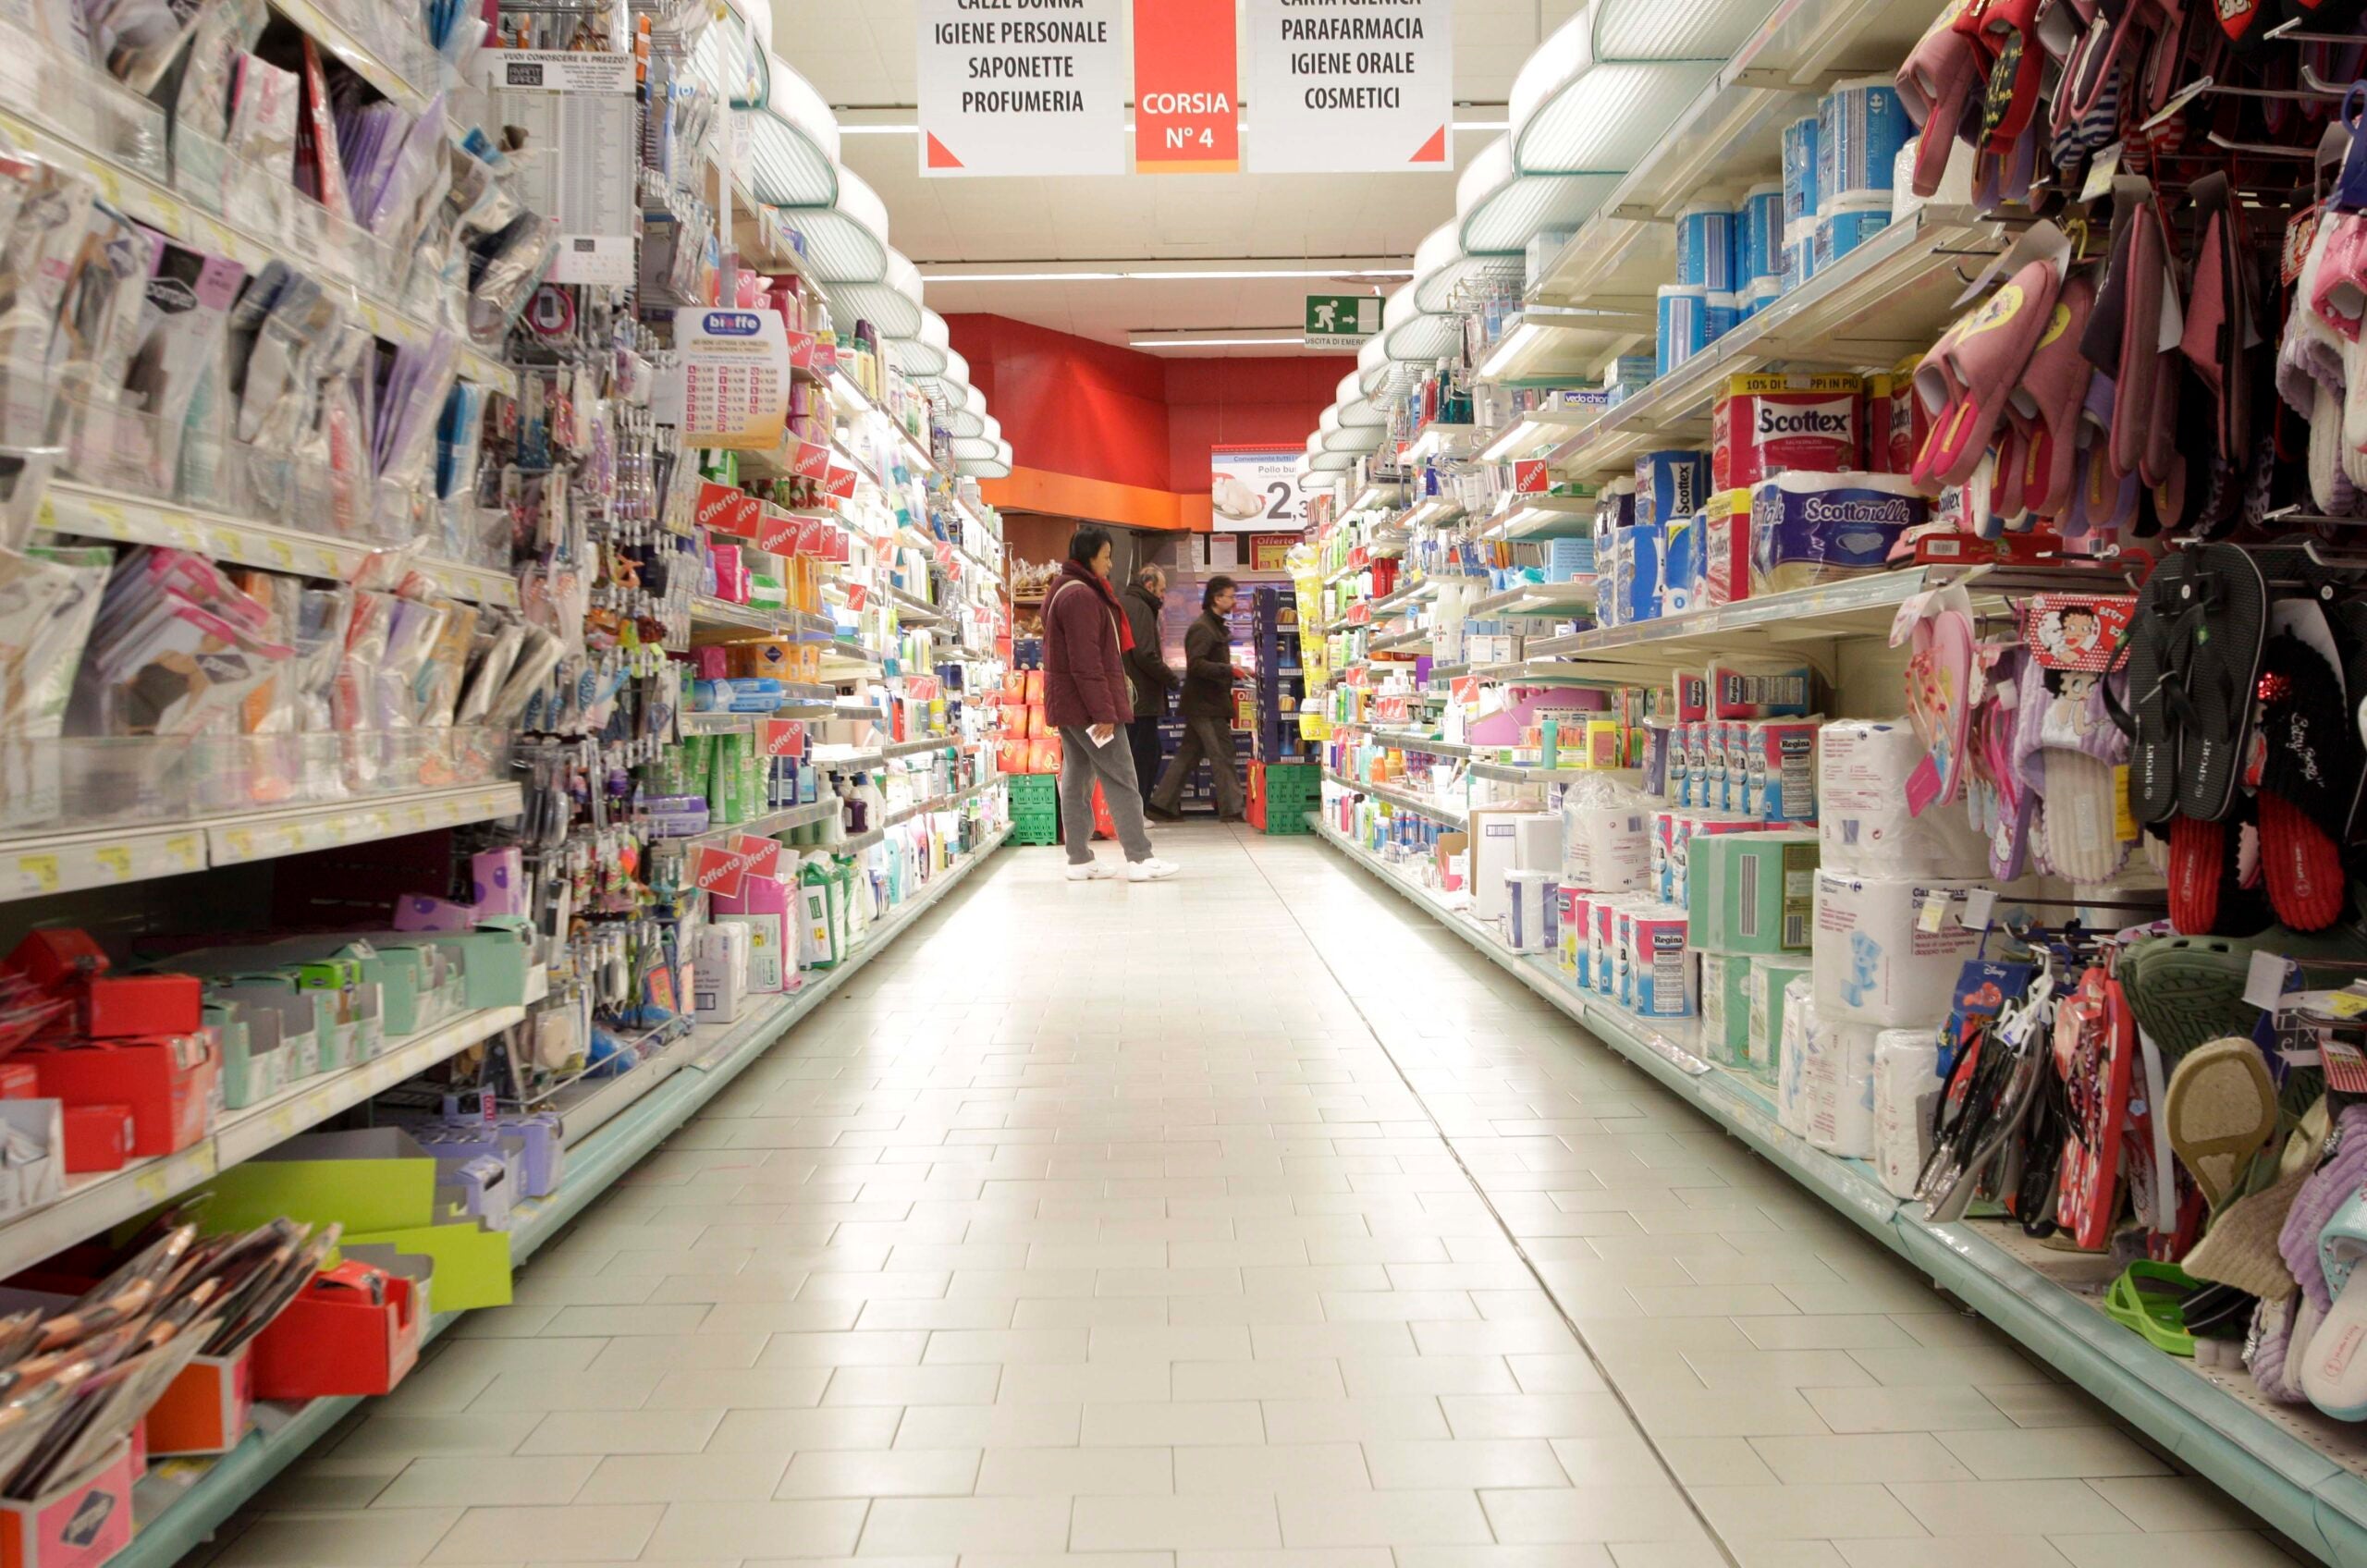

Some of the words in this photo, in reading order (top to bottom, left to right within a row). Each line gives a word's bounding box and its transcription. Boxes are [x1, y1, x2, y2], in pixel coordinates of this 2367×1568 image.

[936, 22, 996, 44] IGIENE
[1001, 21, 1108, 43] PERSONALE
[1282, 18, 1424, 40] PARAFARMACIA
[968, 55, 1073, 78] SAPONETTE
[1292, 53, 1352, 74] IGIENE
[1356, 52, 1415, 73] ORALE
[963, 91, 1084, 113] PROFUMERIA
[1142, 92, 1230, 114] CORSIA
[1305, 87, 1400, 109] COSMETICI
[1165, 128, 1194, 150] N°
[1198, 128, 1214, 148] 4
[1747, 379, 1767, 390] 10%
[1770, 378, 1782, 389] DI
[1829, 377, 1839, 388] IN
[1758, 408, 1847, 434] Scottex
[794, 449, 828, 473] Offerta
[1257, 465, 1281, 473] Pollo
[825, 472, 855, 495] Offerta
[1518, 461, 1545, 492] Offerta
[1677, 464, 1690, 514] Scottex
[698, 490, 739, 523] Offerta
[1805, 496, 1911, 524] Scottonelle
[762, 526, 798, 553] Offerta
[1257, 536, 1294, 545] Offerta
[848, 587, 865, 609] Offerta
[1453, 678, 1475, 704] Offerta
[1730, 676, 1738, 704] Regina
[768, 722, 802, 754] Offerta
[1782, 739, 1810, 749] Regina
[698, 857, 740, 888] Offerta
[1654, 936, 1683, 945] Regina
